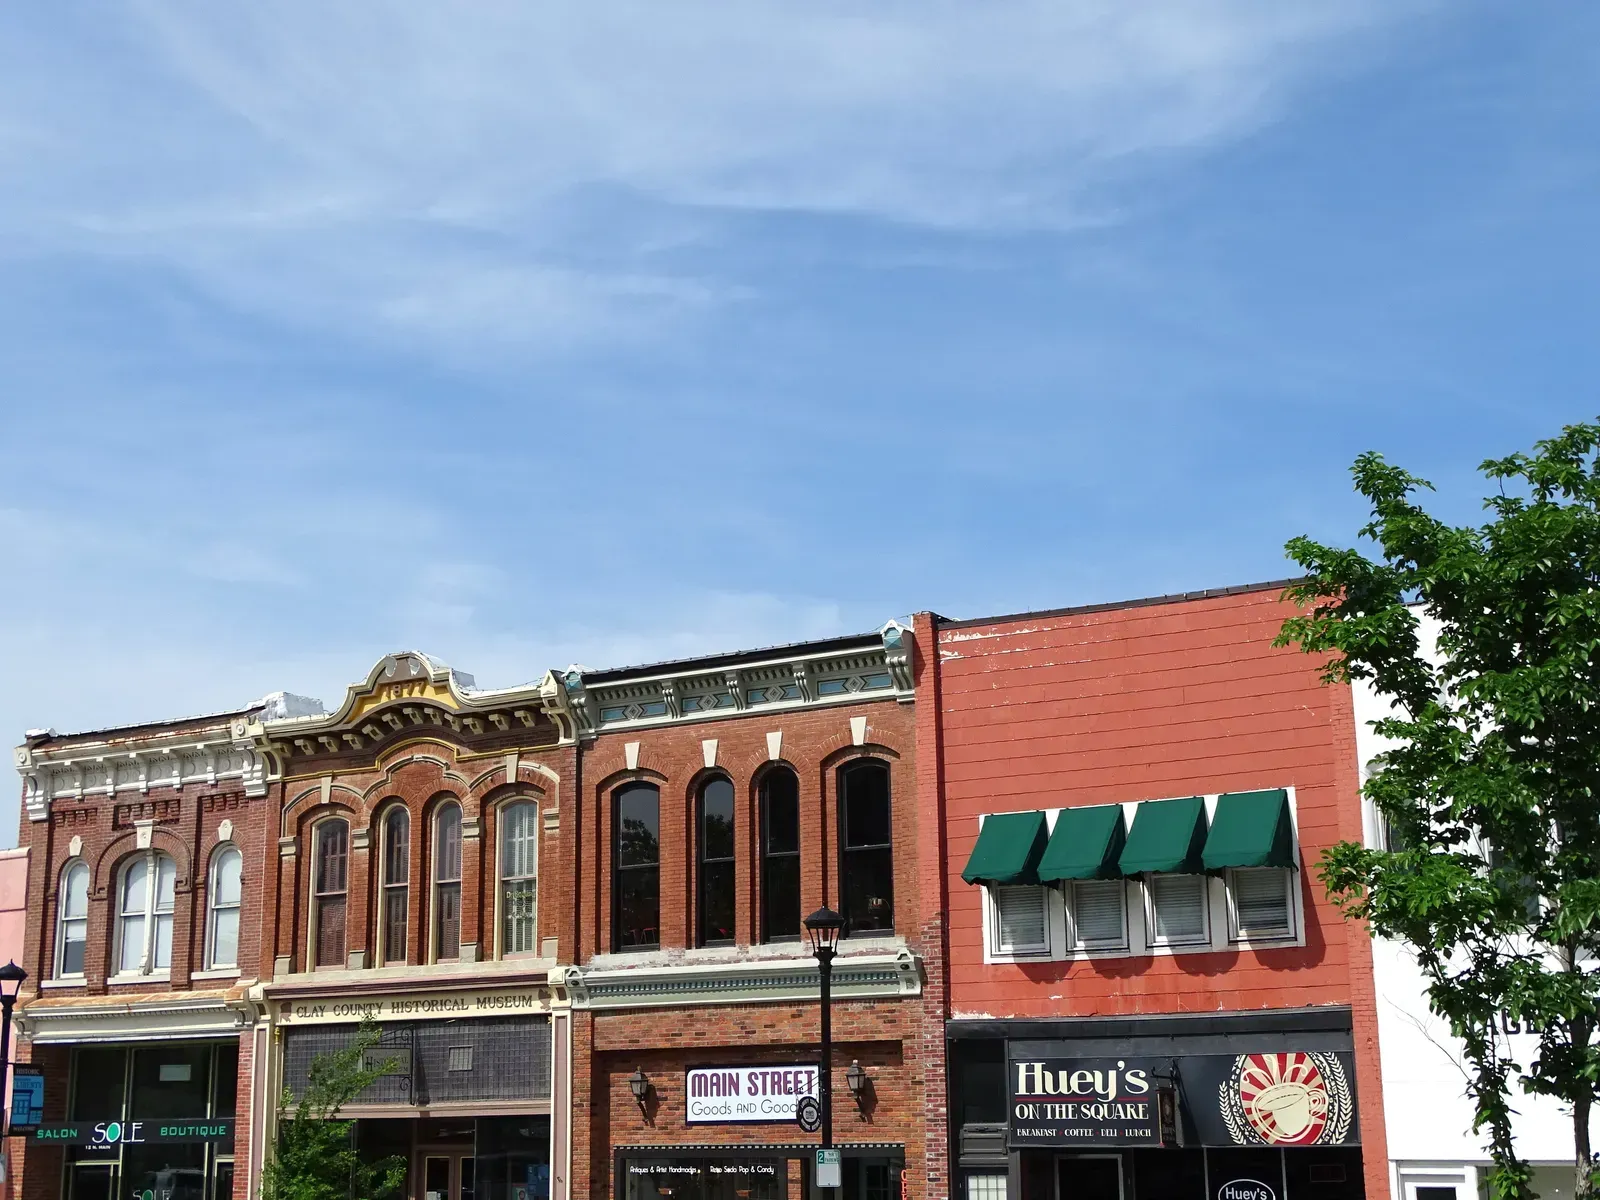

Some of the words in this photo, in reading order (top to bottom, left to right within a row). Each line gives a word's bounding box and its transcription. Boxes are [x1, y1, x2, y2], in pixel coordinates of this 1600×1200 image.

[385, 681, 424, 698] 1877
[296, 1005, 327, 1018] CLAY
[333, 1001, 384, 1017] COUNTY
[391, 998, 469, 1014] HISTORICAL
[476, 995, 533, 1010] MUSEUM
[691, 1072, 740, 1098] MAIN
[747, 1070, 815, 1097] STREET
[1014, 1060, 1149, 1103] Huey's
[691, 1101, 732, 1116] Goods
[736, 1102, 757, 1114] AND
[1015, 1103, 1041, 1120] ON
[1043, 1103, 1078, 1120] THE
[1080, 1103, 1149, 1121] SQUARE
[37, 1128, 78, 1139] SALON
[91, 1122, 145, 1143] SOLE
[160, 1125, 227, 1137] BOUTIQUE
[1016, 1128, 1057, 1137] BREAKFAST
[1064, 1128, 1094, 1137] COFFEE
[1101, 1128, 1118, 1137] DELI
[1125, 1128, 1152, 1137] LUNCH
[818, 1152, 824, 1163] 2
[629, 1165, 649, 1175] Antiques
[650, 1165, 655, 1173] &
[738, 1165, 749, 1175] Pop
[750, 1165, 756, 1173] &
[756, 1165, 775, 1175] Candy
[1224, 1186, 1268, 1200] Huey's
